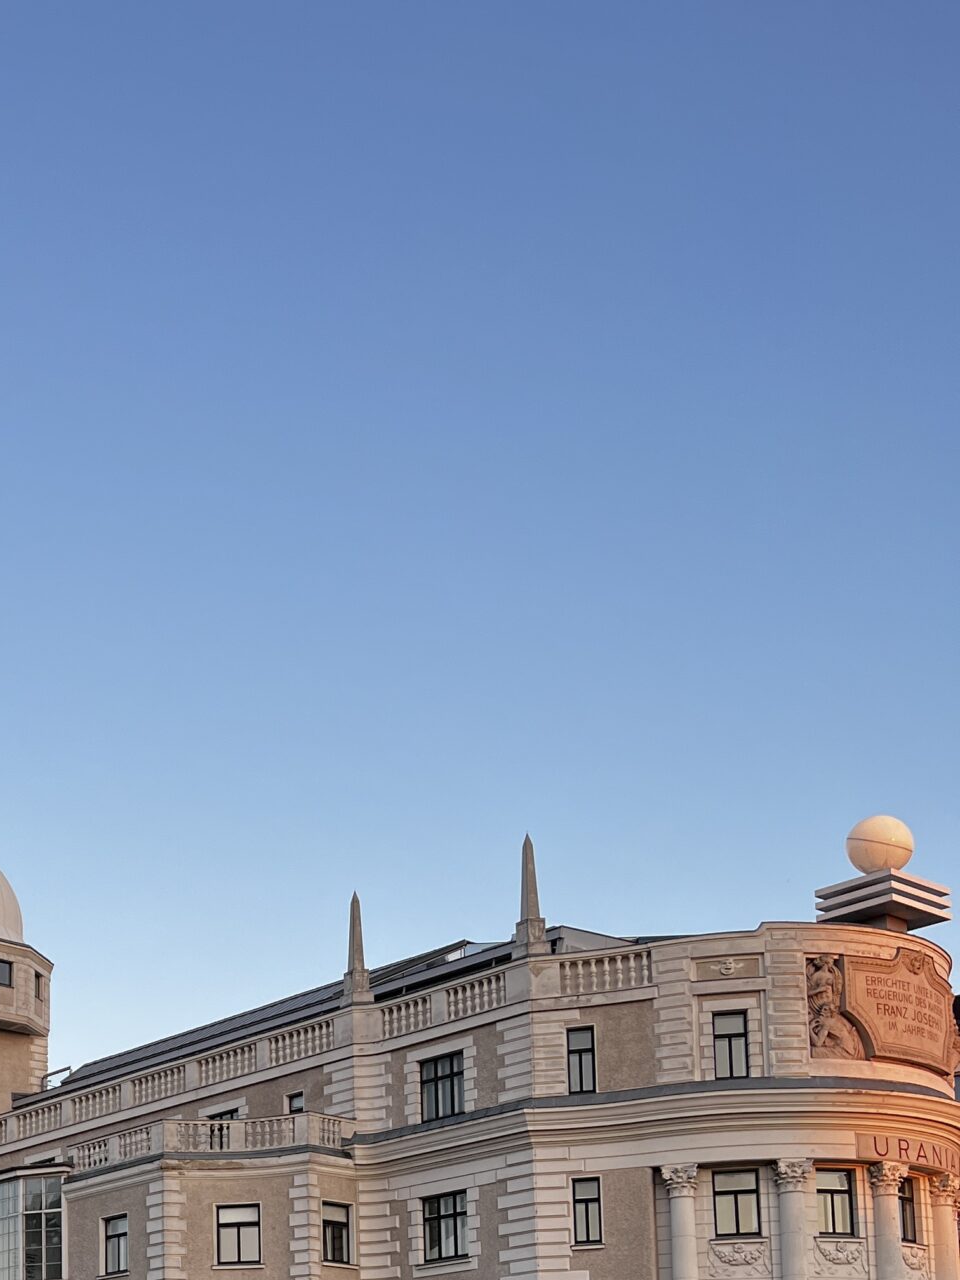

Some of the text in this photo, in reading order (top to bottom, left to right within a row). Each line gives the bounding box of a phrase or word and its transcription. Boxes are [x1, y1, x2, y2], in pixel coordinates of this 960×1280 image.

[865, 975, 910, 992] ERRICHTET
[866, 987, 913, 1005] REGIERUNG
[876, 1002, 908, 1020] FRANZ
[888, 1020, 898, 1032] IM
[902, 1023, 925, 1038] JAHRE
[873, 1135, 956, 1171] URANIA
